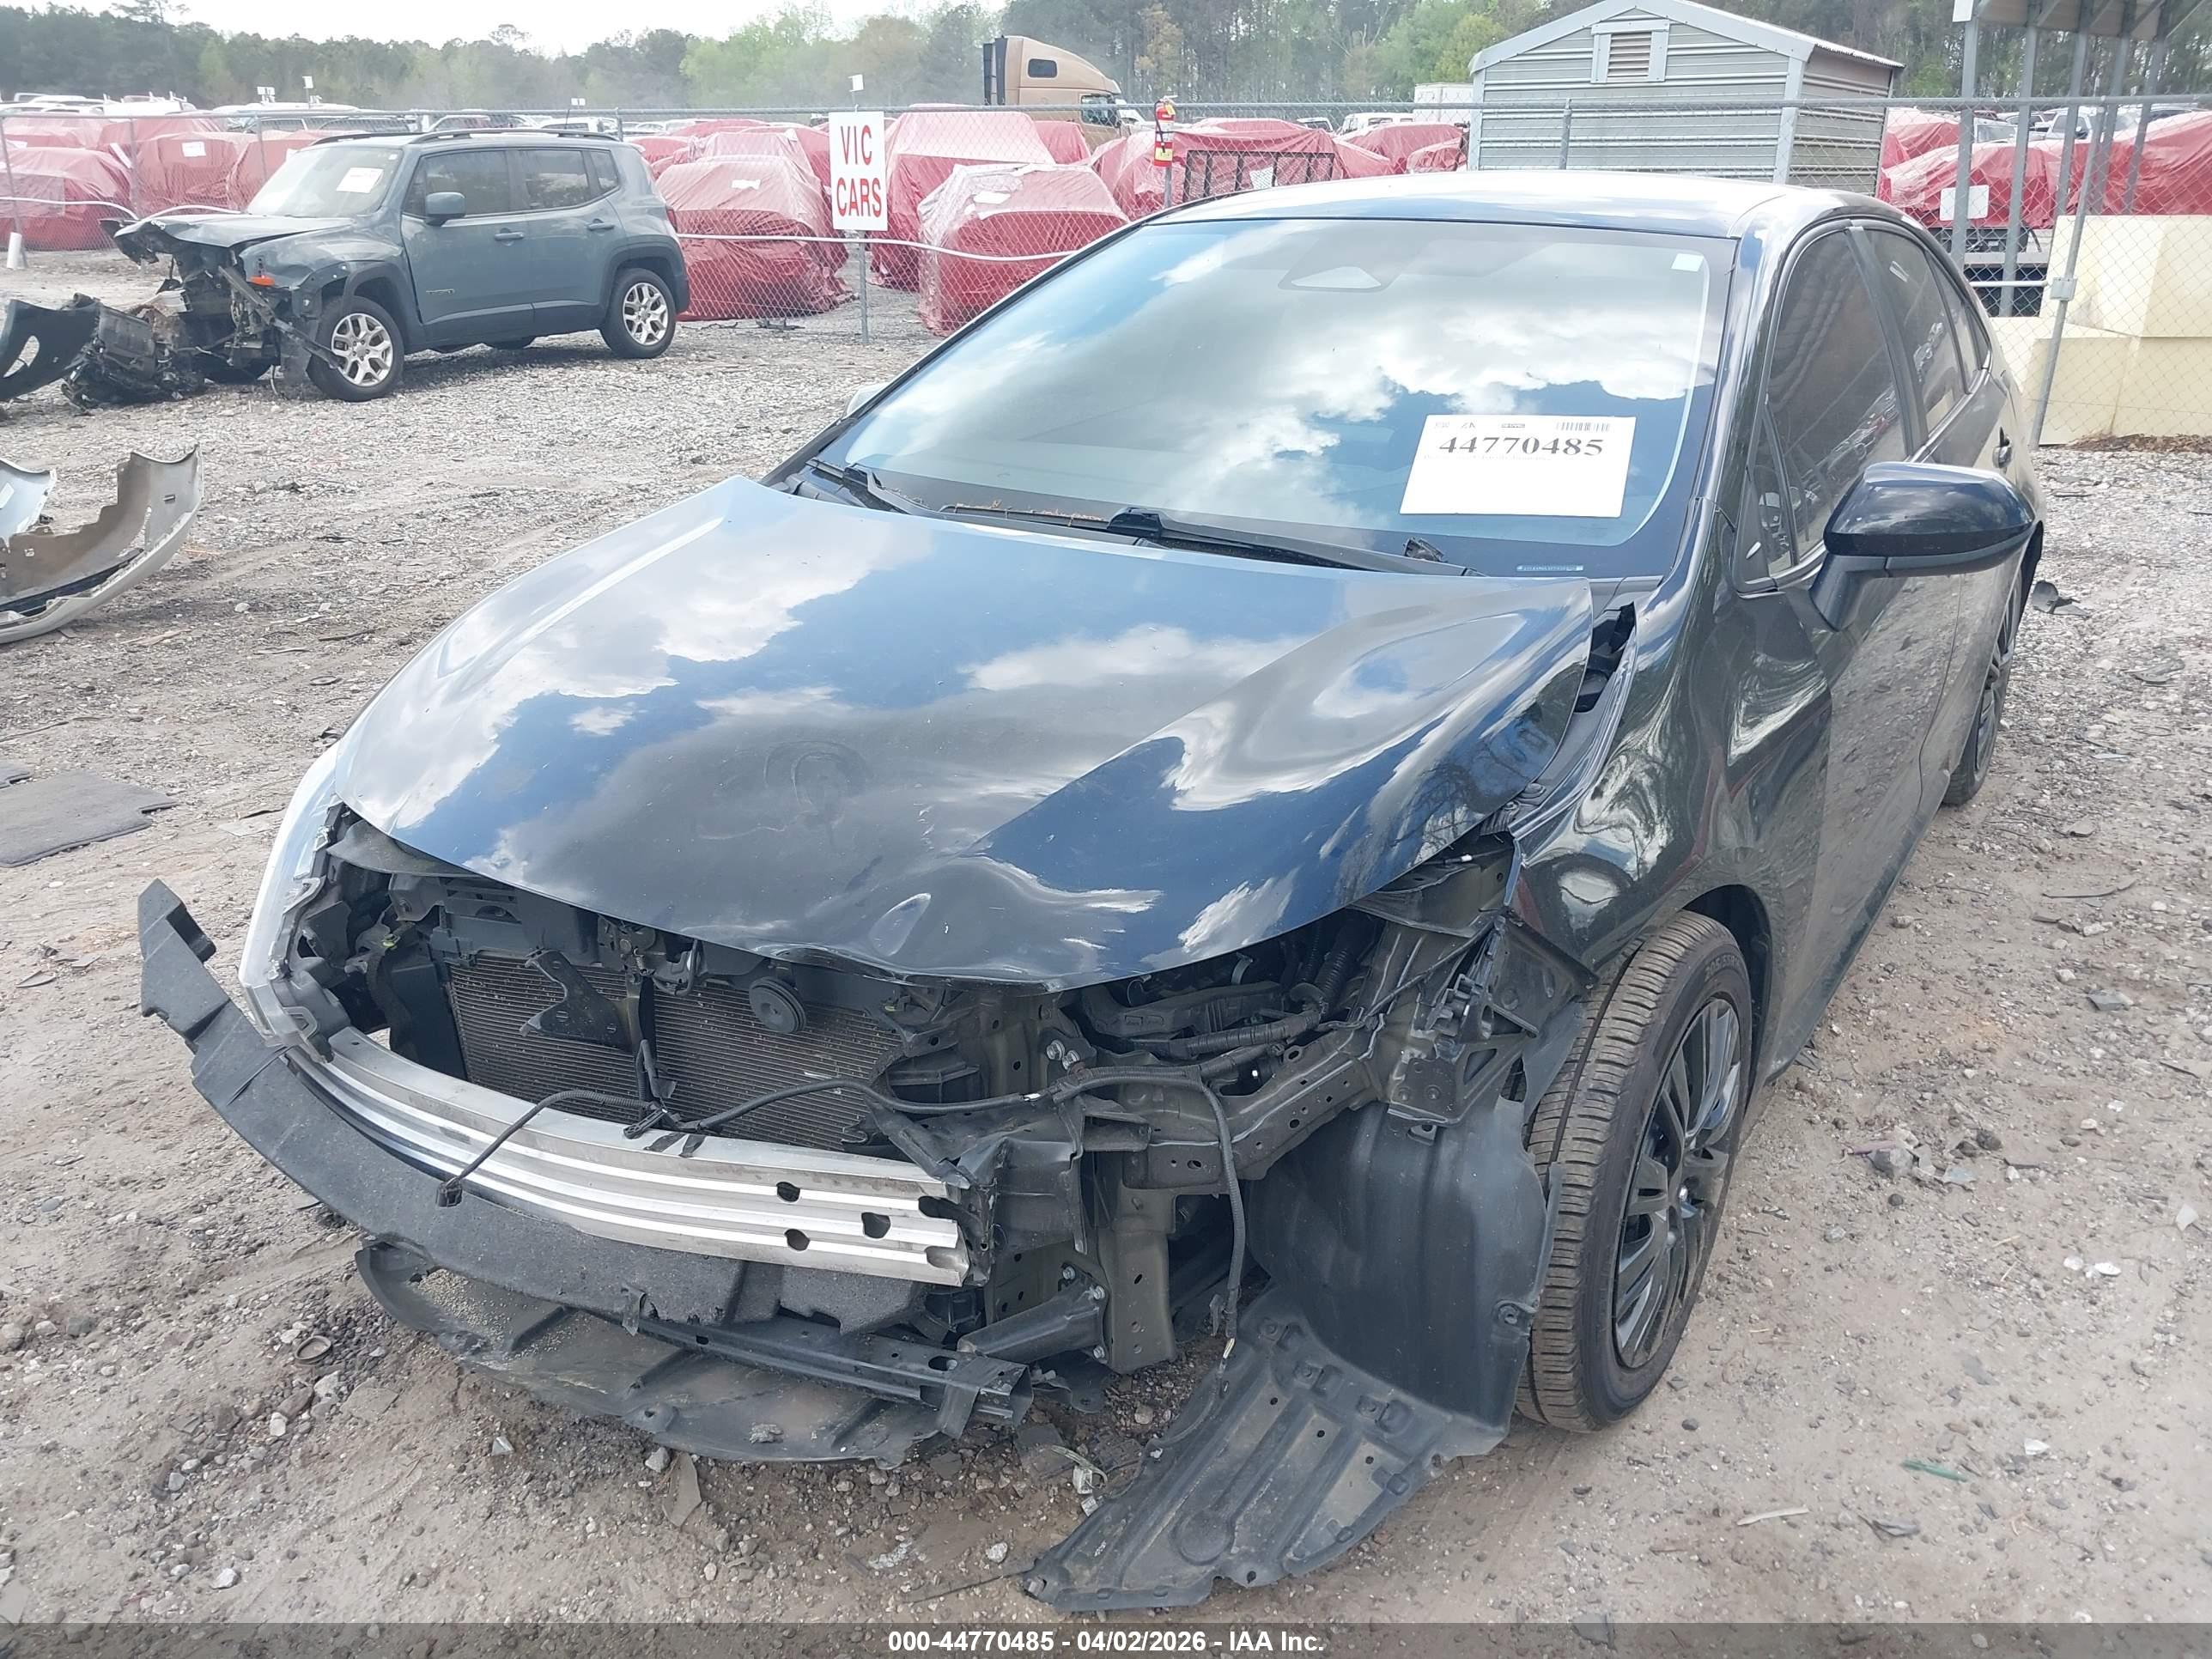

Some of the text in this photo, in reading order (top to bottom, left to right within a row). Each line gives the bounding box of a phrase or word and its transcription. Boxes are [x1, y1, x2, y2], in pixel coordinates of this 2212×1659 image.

[840, 125, 872, 165] VIC
[836, 177, 882, 217] CARS
[1438, 436, 1604, 456] 44770485
